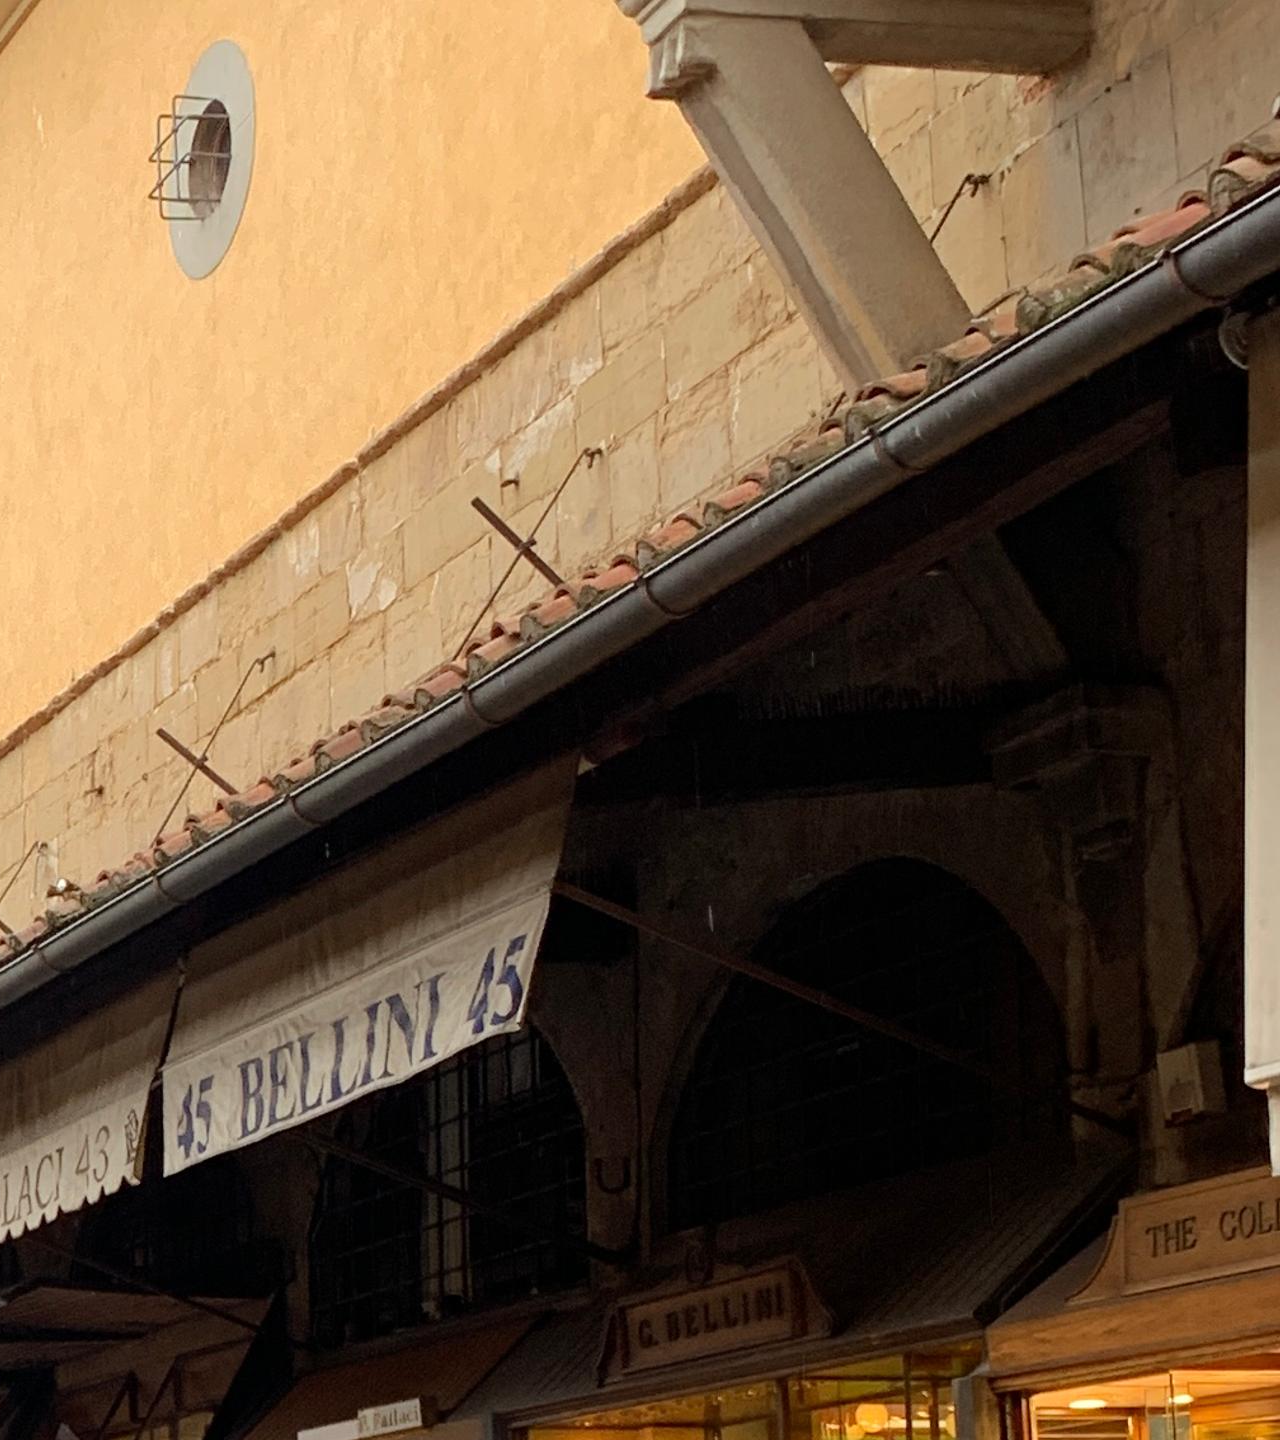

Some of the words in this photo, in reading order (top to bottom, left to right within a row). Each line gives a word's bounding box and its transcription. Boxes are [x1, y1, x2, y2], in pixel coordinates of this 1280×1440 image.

[177, 1074, 215, 1160] 45
[237, 971, 447, 1141] BELLINI
[467, 933, 529, 1035] 45
[74, 1124, 111, 1192] 43
[1145, 1215, 1198, 1258] THE
[666, 1282, 785, 1343] BELLINI
